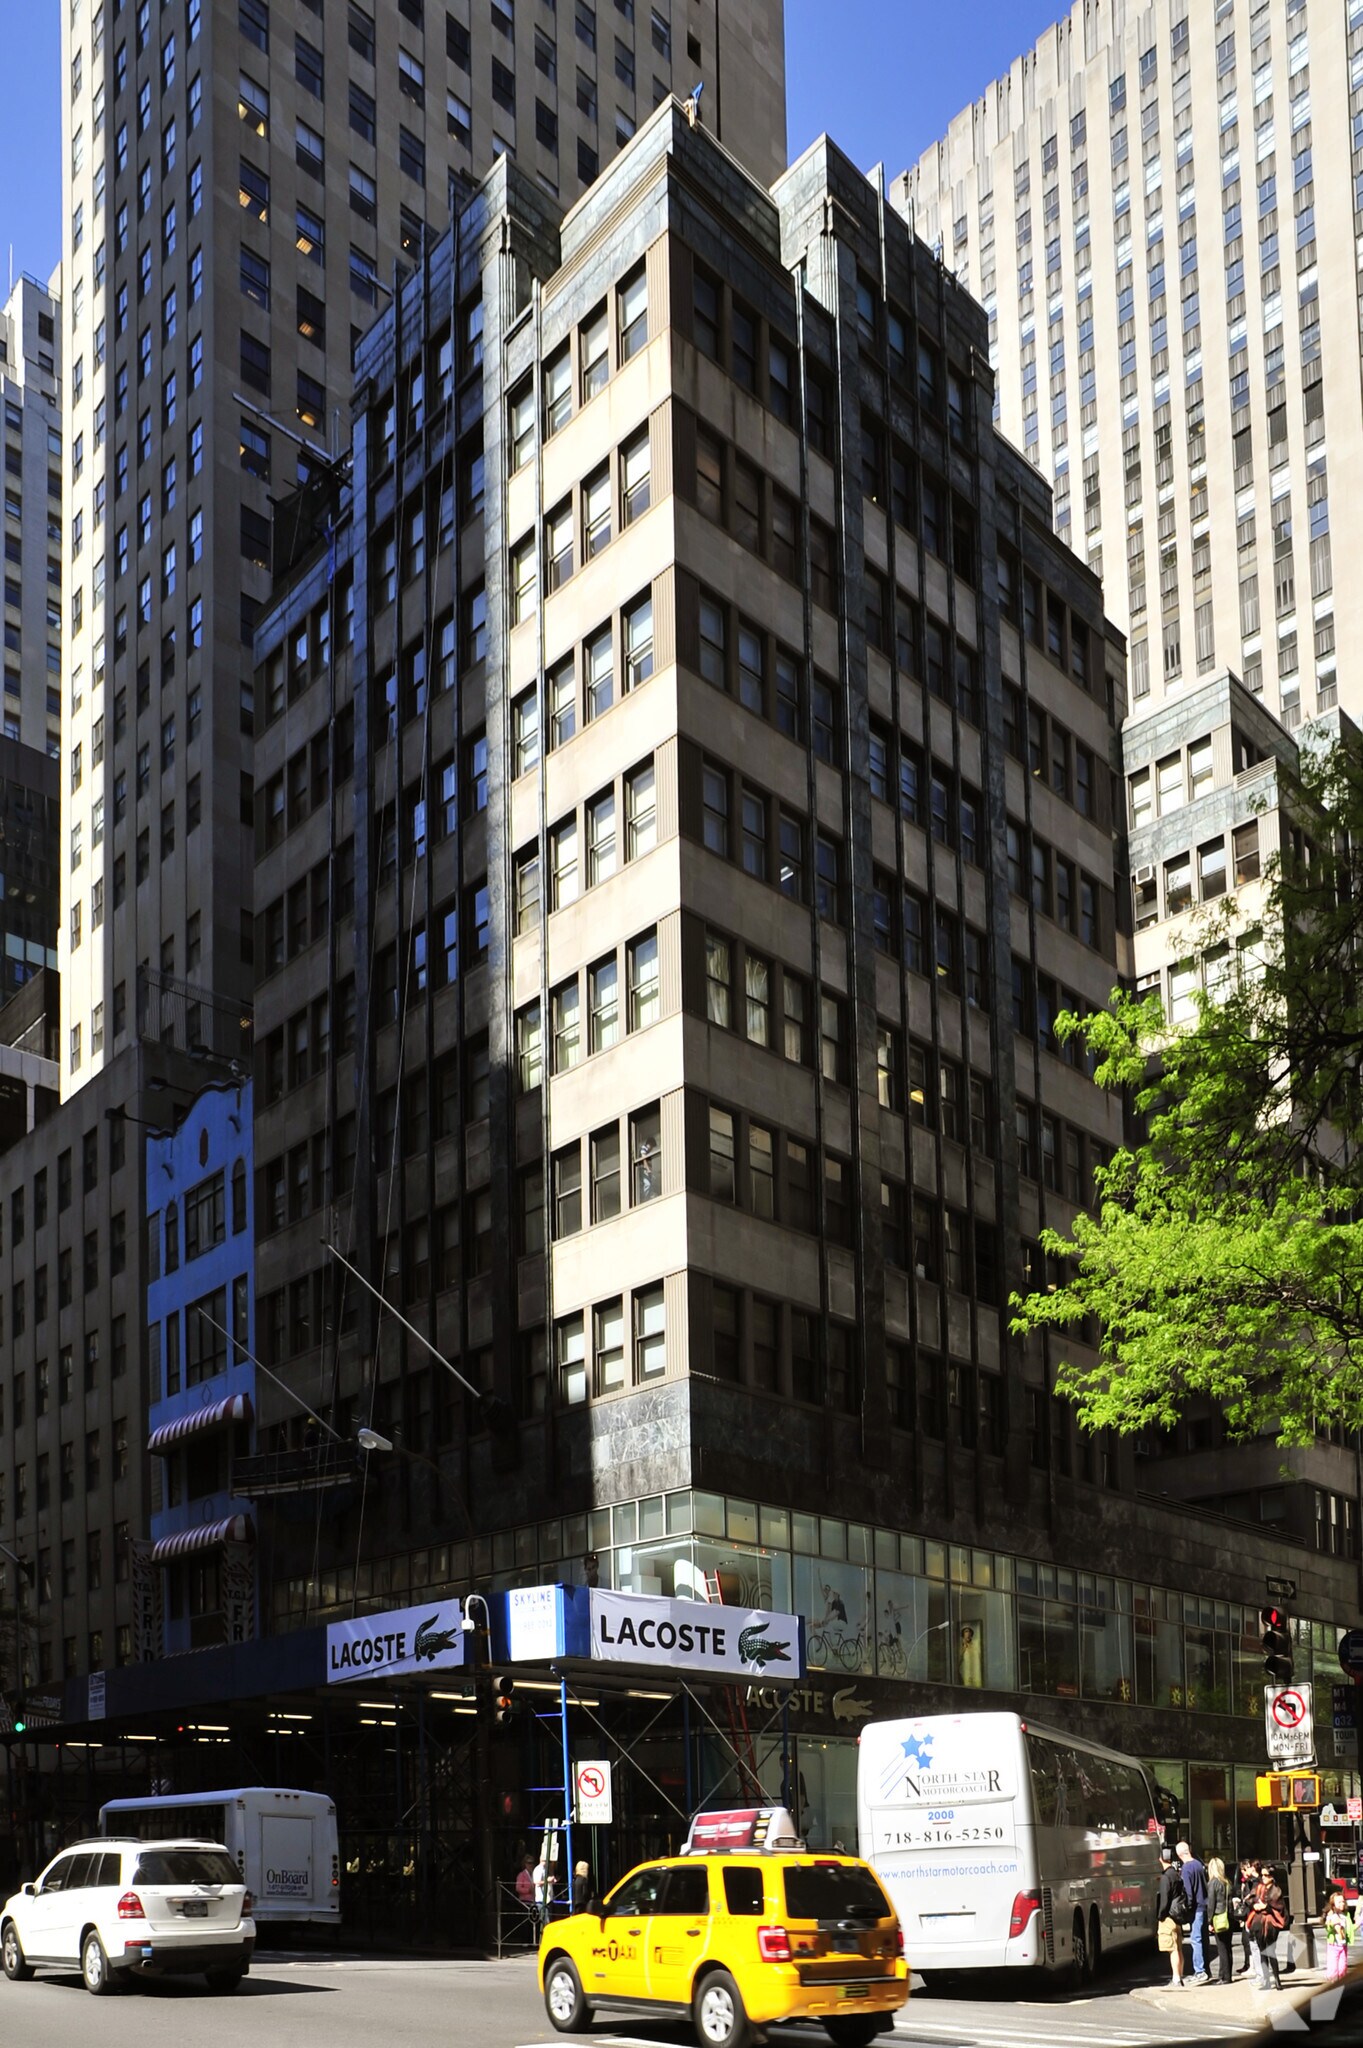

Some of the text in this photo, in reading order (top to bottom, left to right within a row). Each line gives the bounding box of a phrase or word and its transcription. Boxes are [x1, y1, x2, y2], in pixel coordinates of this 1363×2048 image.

[514, 1590, 552, 1607] SKYLINE
[600, 1614, 726, 1656] LACOSTE
[331, 1632, 406, 1670] LACOSTE
[1335, 1716, 1353, 1726] Q32
[1335, 1731, 1355, 1740] TOUR
[1273, 1743, 1308, 1752] MON-FRI
[1336, 1745, 1346, 1754] NJ
[905, 1770, 1002, 1798] NORTH STAR
[922, 1785, 987, 1796] MOTORCOACH
[928, 1810, 954, 1821] 2008
[884, 1827, 1003, 1845] 718-816-5250
[266, 1869, 309, 1885] OnBoard
